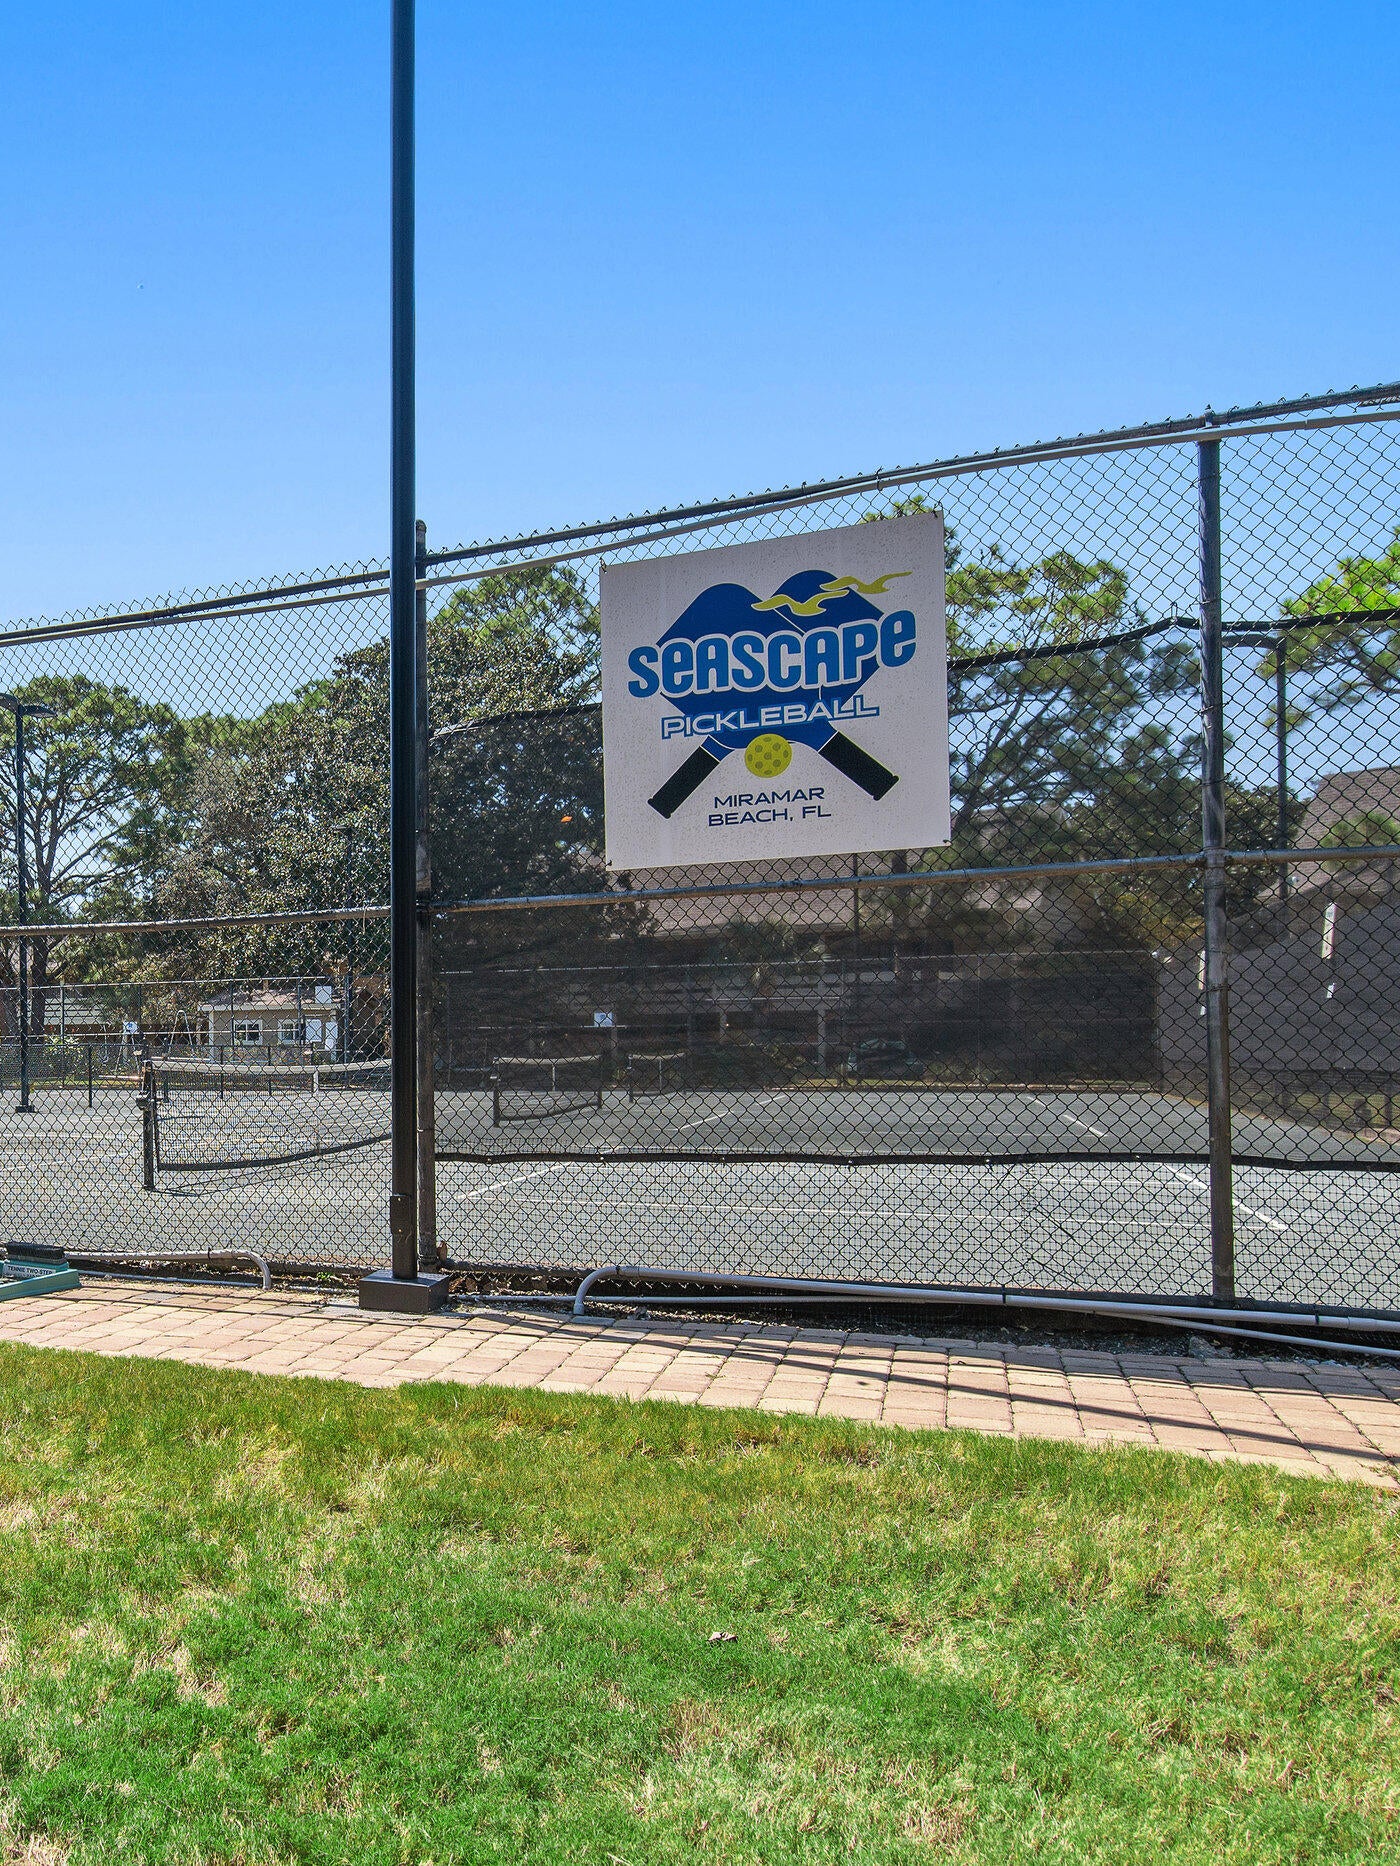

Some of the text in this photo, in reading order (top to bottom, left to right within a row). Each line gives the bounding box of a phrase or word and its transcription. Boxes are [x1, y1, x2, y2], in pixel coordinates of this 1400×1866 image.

[662, 695, 880, 740] PICKLEBALL
[714, 787, 825, 808] MIRAMAR
[708, 805, 832, 826] BEACH, FL
